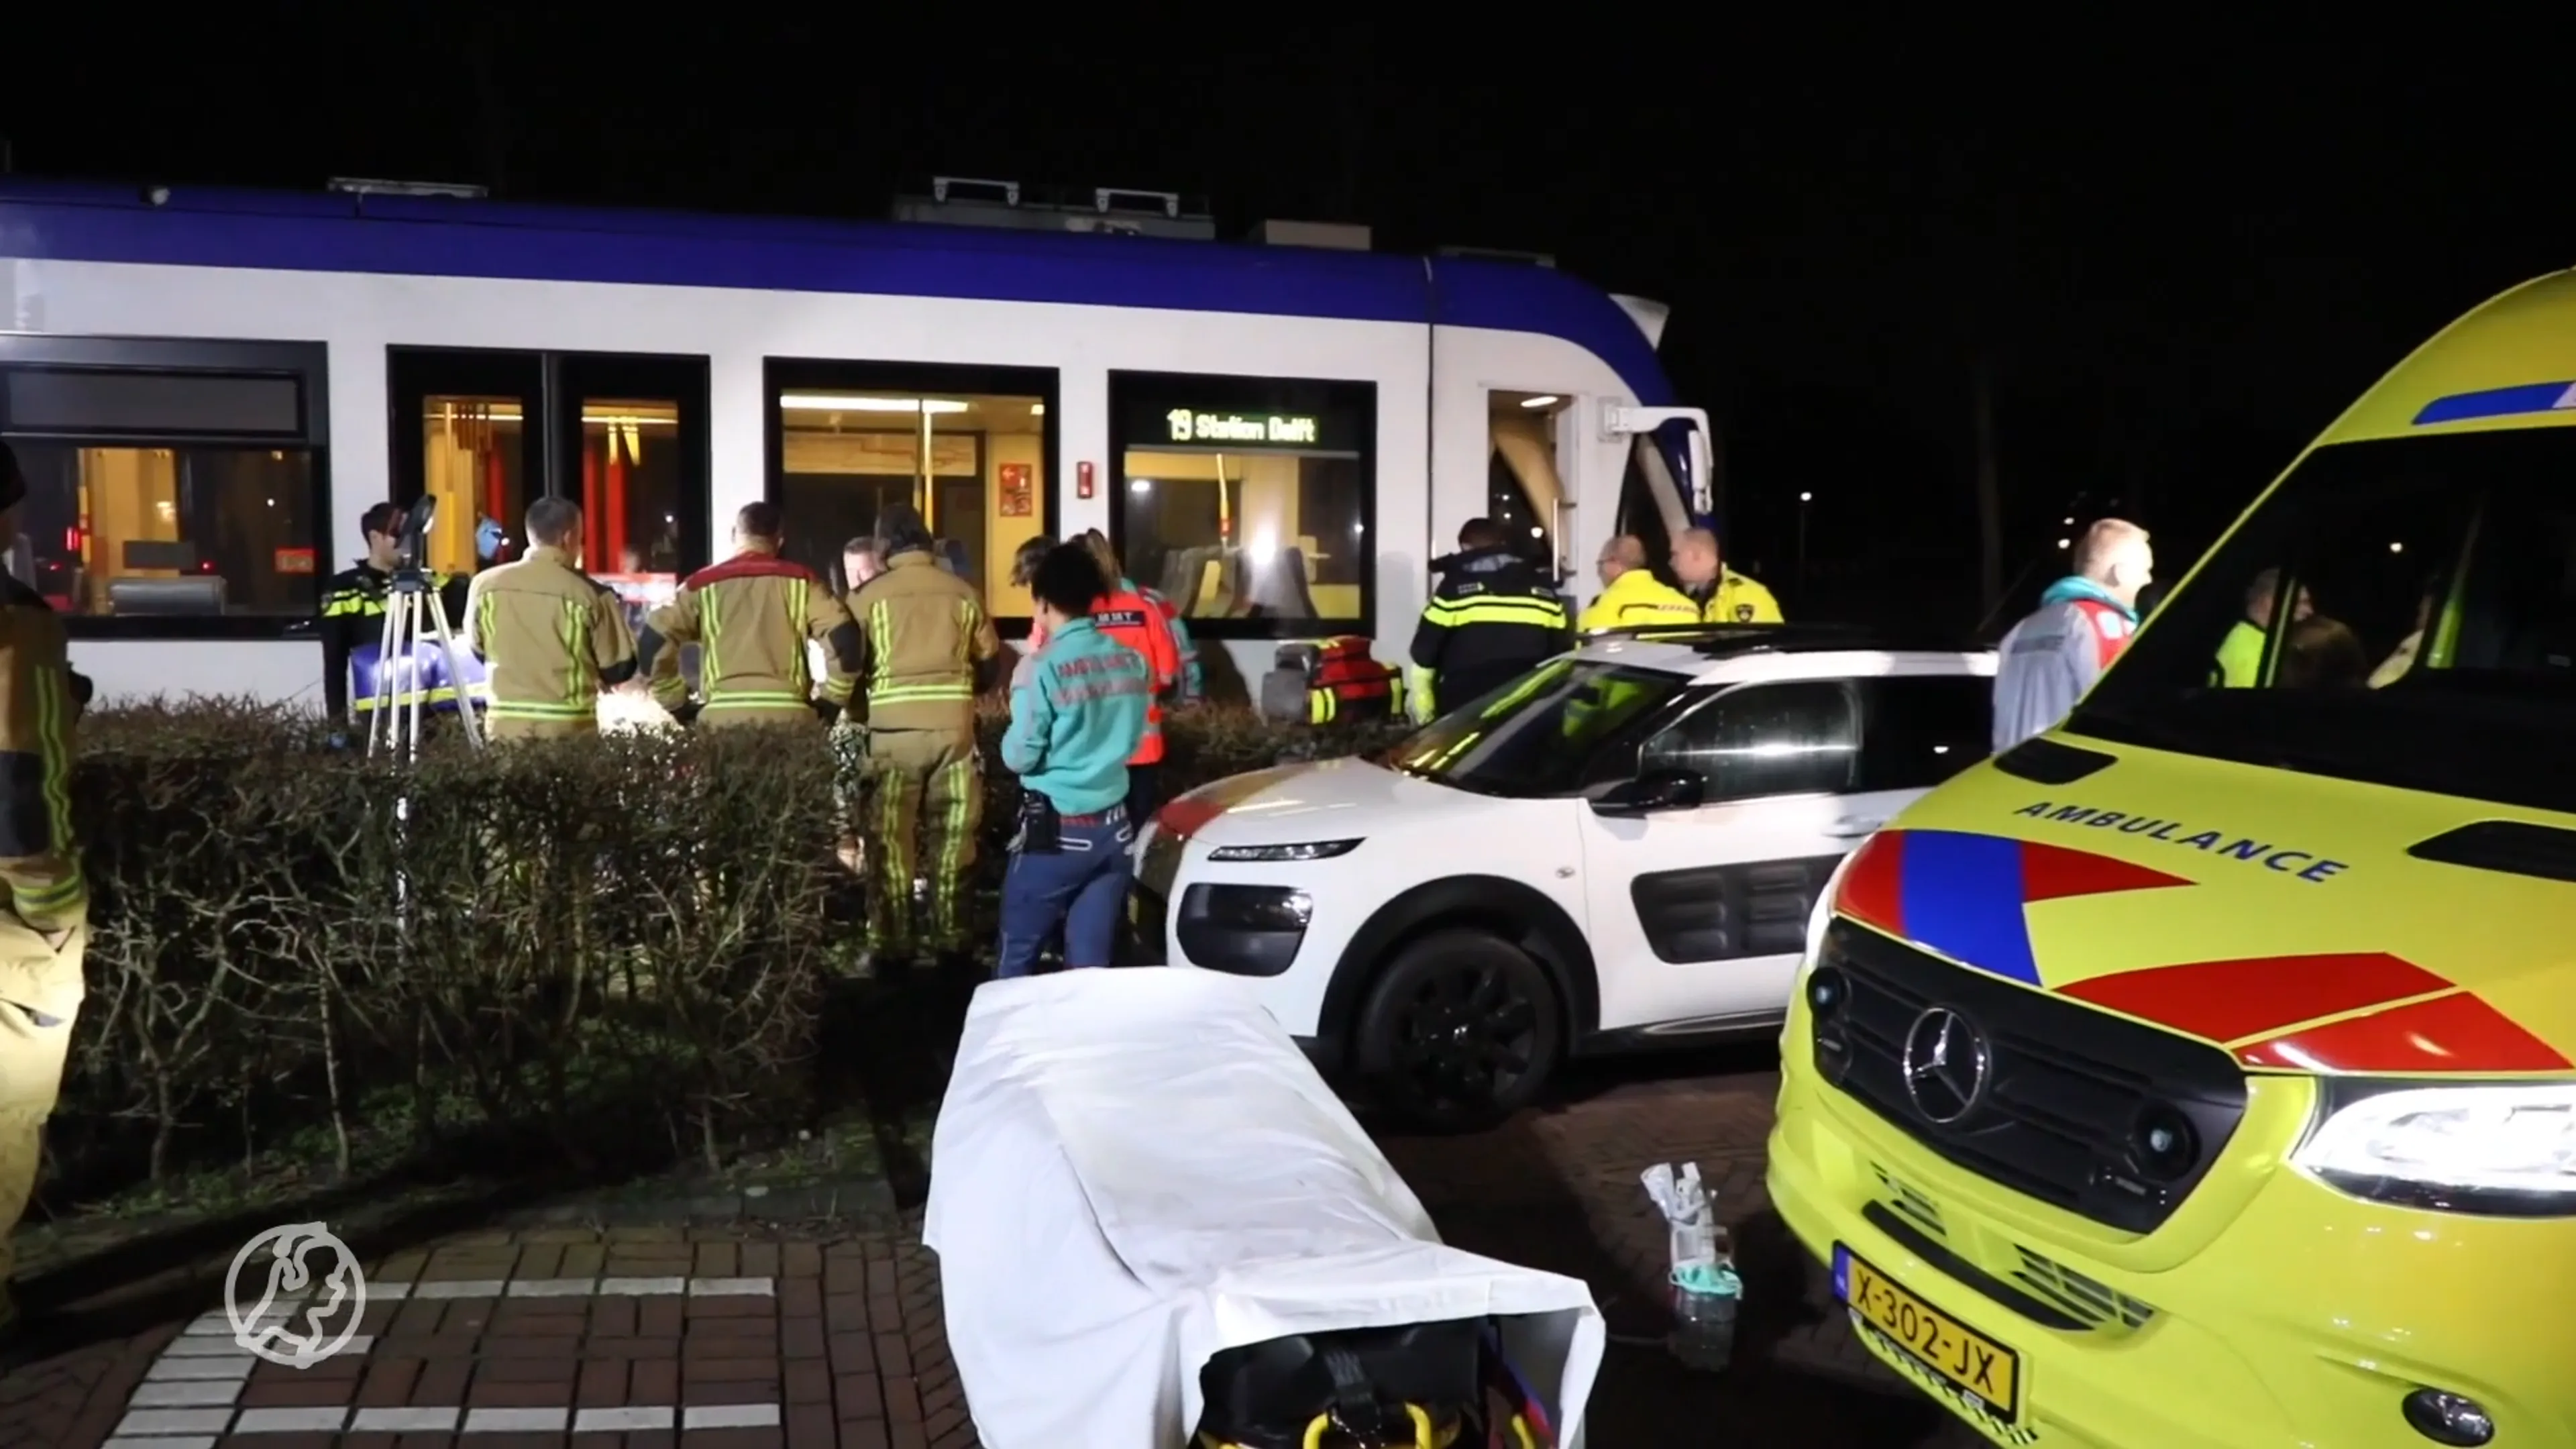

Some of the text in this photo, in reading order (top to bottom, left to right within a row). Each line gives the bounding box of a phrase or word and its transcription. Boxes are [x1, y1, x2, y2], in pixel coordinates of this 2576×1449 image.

[1196, 414, 1265, 440] Station
[1269, 416, 1316, 441] Delft
[2012, 801, 2349, 883] AMBULANCE
[1856, 1269, 1994, 1395] X-302-JX
